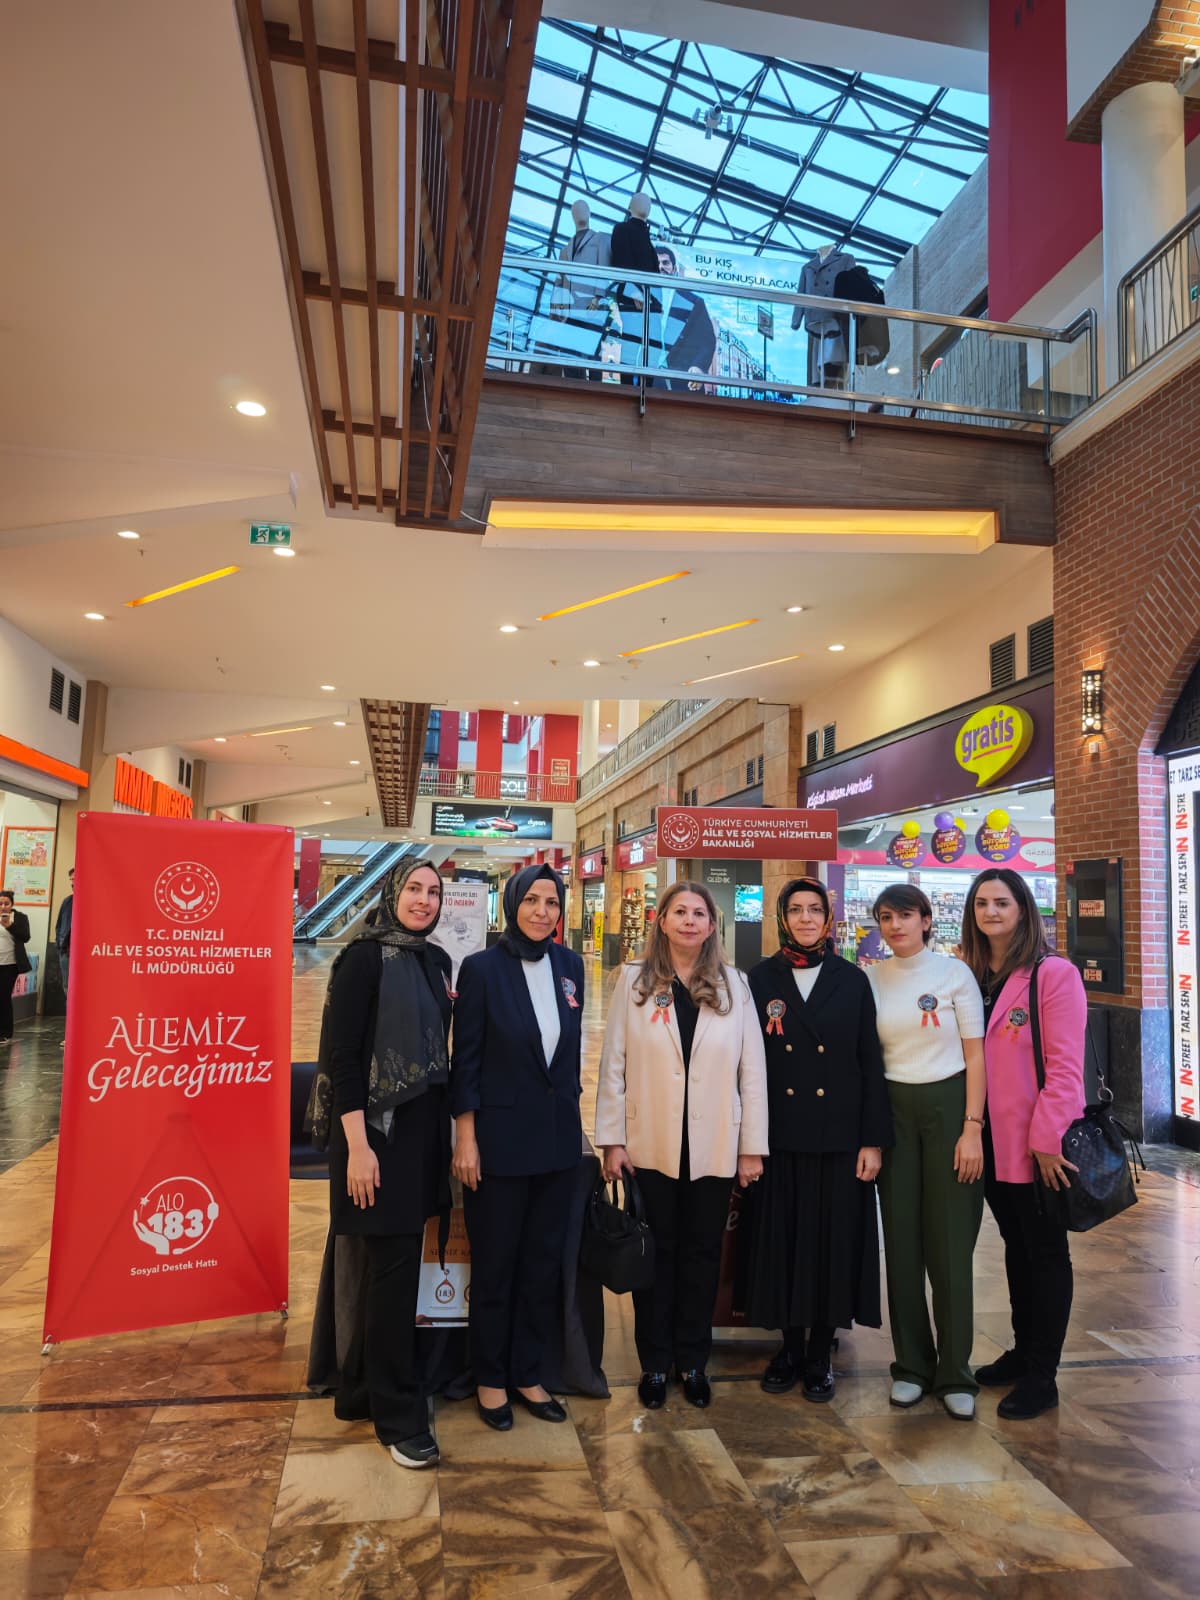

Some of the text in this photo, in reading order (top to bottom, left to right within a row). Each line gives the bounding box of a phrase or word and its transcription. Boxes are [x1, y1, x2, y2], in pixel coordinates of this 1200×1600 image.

[695, 255, 732, 271] BU KIŞ
[716, 272, 798, 289] KONUŞULACAK
[961, 709, 1014, 763] gratis
[1178, 767, 1193, 784] TARZ
[527, 818, 546, 827] dyson
[703, 818, 808, 829] TÜRKİYE CUMHURİYETİ
[702, 829, 723, 837] AİLE
[741, 830, 776, 839] SOSYAL
[779, 830, 833, 839] HİZMETLER
[702, 839, 755, 849] BAKANLIĞI
[1178, 872, 1188, 895] TARZ
[146, 929, 224, 941] T.C. DENİZLİ
[91, 943, 272, 958] AİLE VE SOSYAL HİZMETLER
[132, 960, 235, 974] İL MÜDÜRLÜĞÜ
[1181, 1009, 1191, 1033] TARZ
[105, 1011, 260, 1055] AİLEMİZ
[87, 1051, 273, 1102] Geleceğimiz
[155, 1192, 184, 1212] ALO
[147, 1208, 204, 1240] 183
[130, 1259, 218, 1276] Sosyal Destek Hattı
